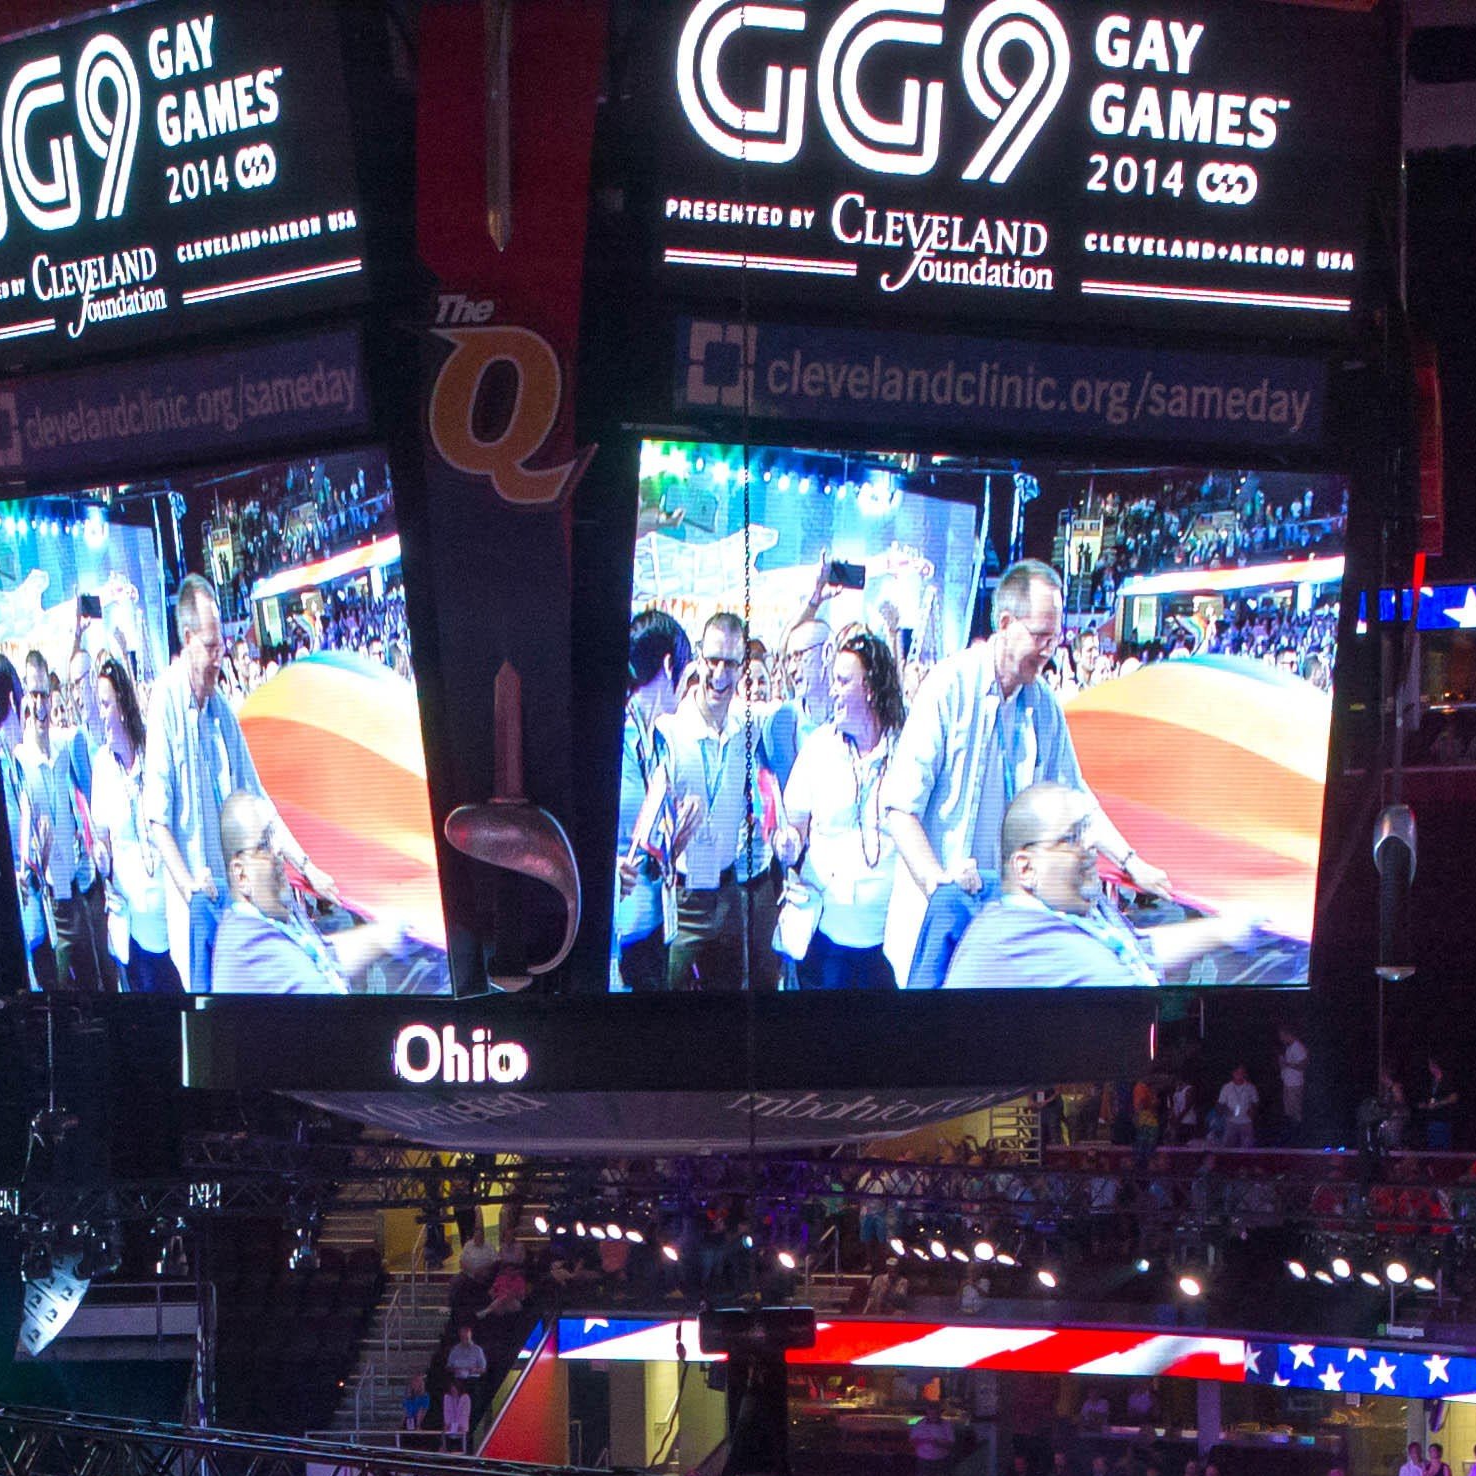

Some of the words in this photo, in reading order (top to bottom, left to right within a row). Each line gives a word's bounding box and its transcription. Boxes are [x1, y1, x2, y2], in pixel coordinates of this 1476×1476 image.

[148, 15, 214, 78] GAY
[1095, 15, 1203, 74] GAY
[157, 70, 282, 147] GAMES
[677, 0, 1071, 184] GG9
[1090, 83, 1278, 149] GAMES
[165, 153, 229, 205] 2014
[1088, 156, 1183, 197] 2014
[328, 209, 356, 233] USA
[666, 200, 784, 226] PRESENTED
[789, 209, 814, 230] BY
[831, 193, 1048, 257] CLEVELAND
[10, 278, 25, 298] BY
[32, 246, 157, 302] CLEVELAND
[1318, 251, 1354, 271] USA
[434, 295, 494, 324] The
[25, 361, 356, 450] clevelandclinic.org/sameday
[429, 327, 583, 506] Q
[767, 350, 1310, 432] clevelandclinic.org/sameday
[392, 1024, 529, 1083] Ohio
